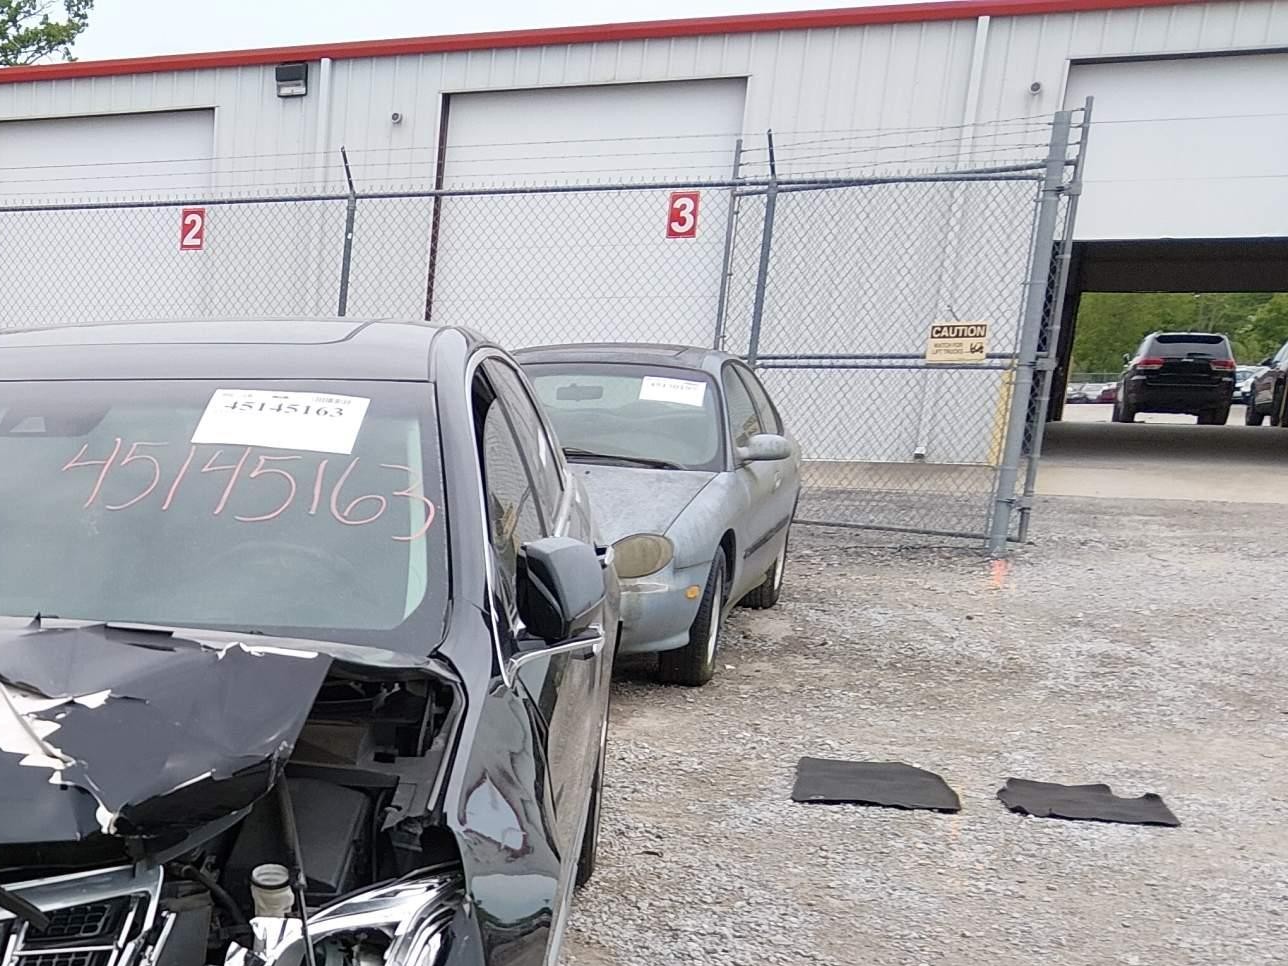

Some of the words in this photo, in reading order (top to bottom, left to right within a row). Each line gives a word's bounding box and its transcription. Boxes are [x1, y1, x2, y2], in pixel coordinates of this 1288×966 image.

[183, 213, 202, 246] 2
[671, 197, 695, 233] 3
[932, 326, 985, 337] CAUTION
[224, 401, 344, 418] 45145163
[62, 437, 436, 542] 45145163
